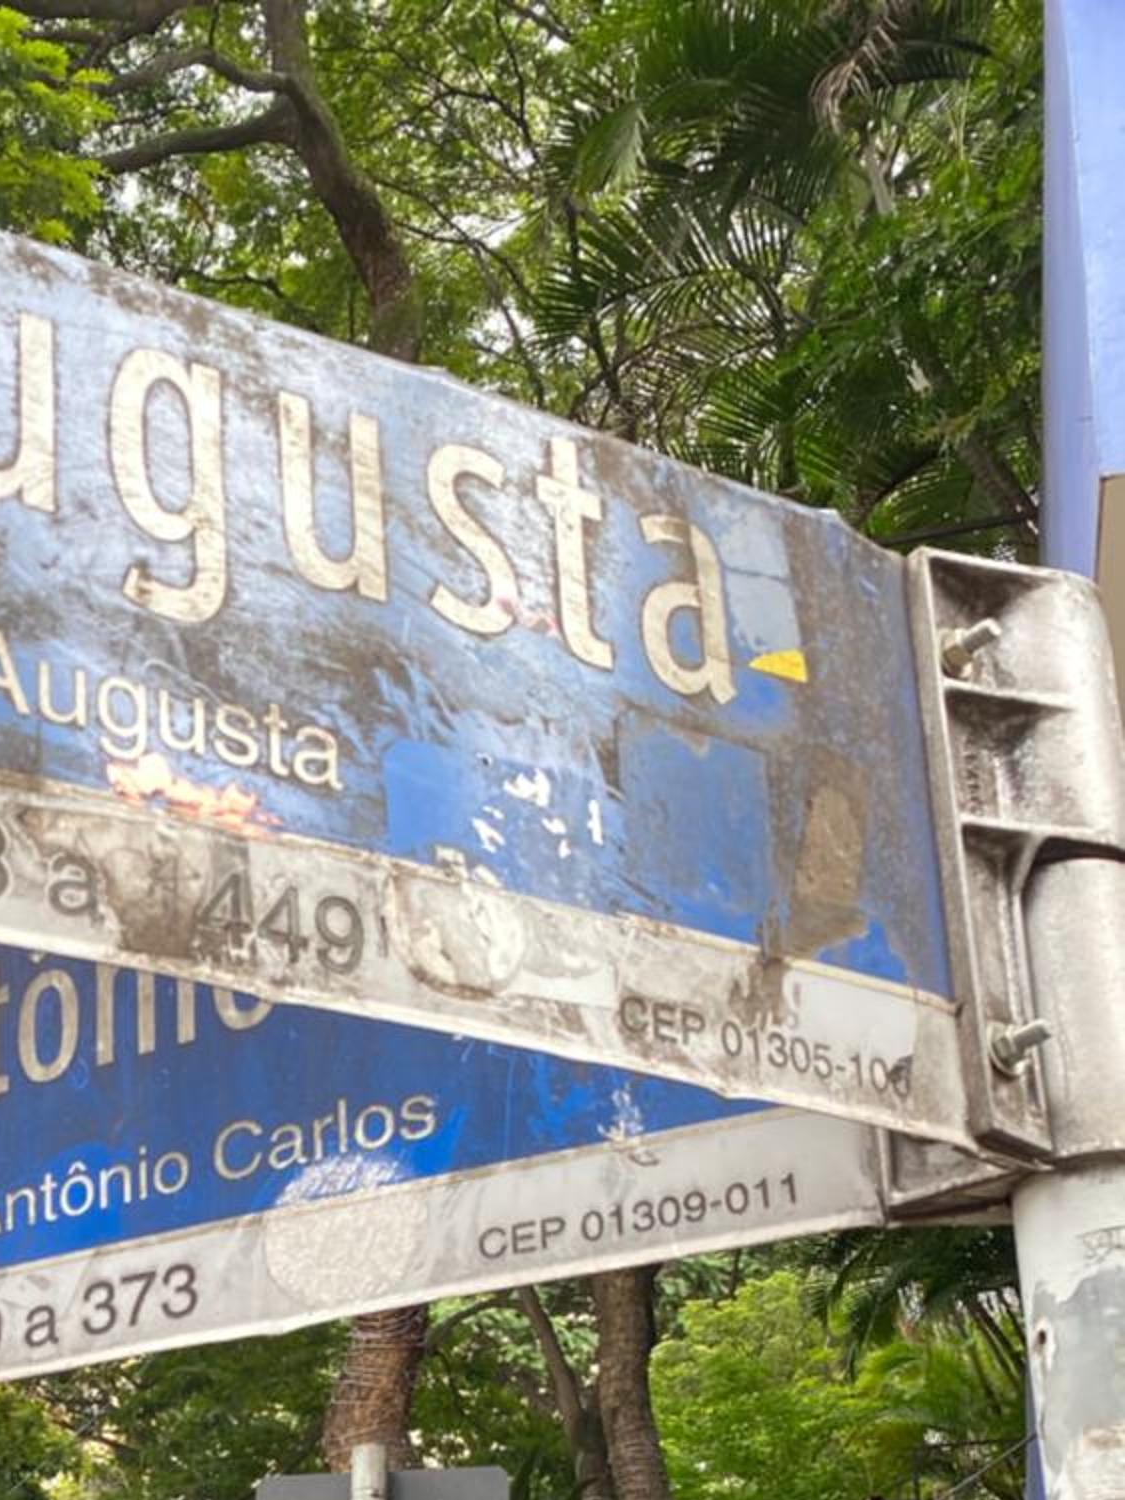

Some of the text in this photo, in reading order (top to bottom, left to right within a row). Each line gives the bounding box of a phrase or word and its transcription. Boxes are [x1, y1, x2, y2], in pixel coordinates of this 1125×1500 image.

[47, 852, 105, 917] a
[619, 996, 706, 1046] CEP
[213, 1093, 439, 1181] Carlos
[24, 1304, 59, 1347] a
[81, 1263, 200, 1337] 373
[478, 1216, 566, 1259] CEP
[581, 1172, 798, 1242] 01309-011
